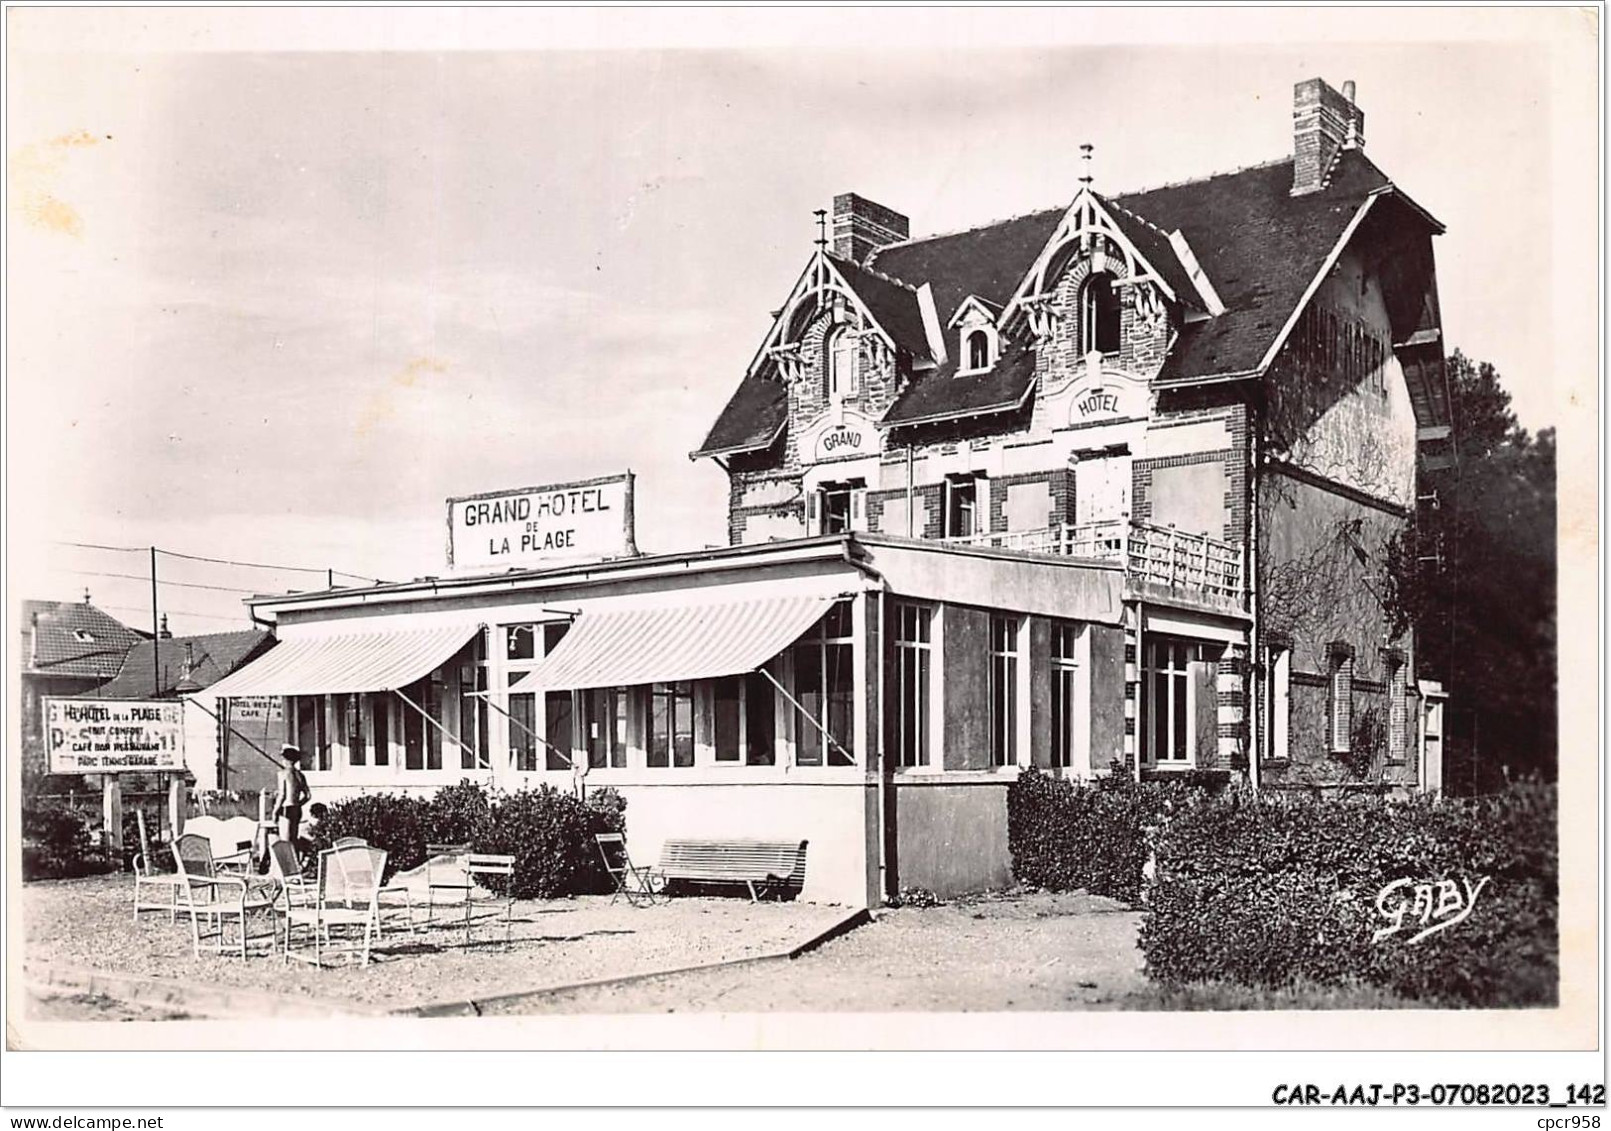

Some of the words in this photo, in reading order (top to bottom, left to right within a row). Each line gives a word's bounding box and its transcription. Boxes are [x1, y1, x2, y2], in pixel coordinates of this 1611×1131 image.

[1078, 394, 1118, 417] HOTEL
[823, 431, 862, 451] GRAND
[465, 498, 530, 526] GRAND
[538, 489, 610, 517] HOTEL
[526, 521, 538, 532] DE
[489, 538, 510, 555] LA
[522, 530, 575, 551] PLAGE
[131, 707, 161, 721] PLAGE
[102, 756, 127, 766] TENNIS
